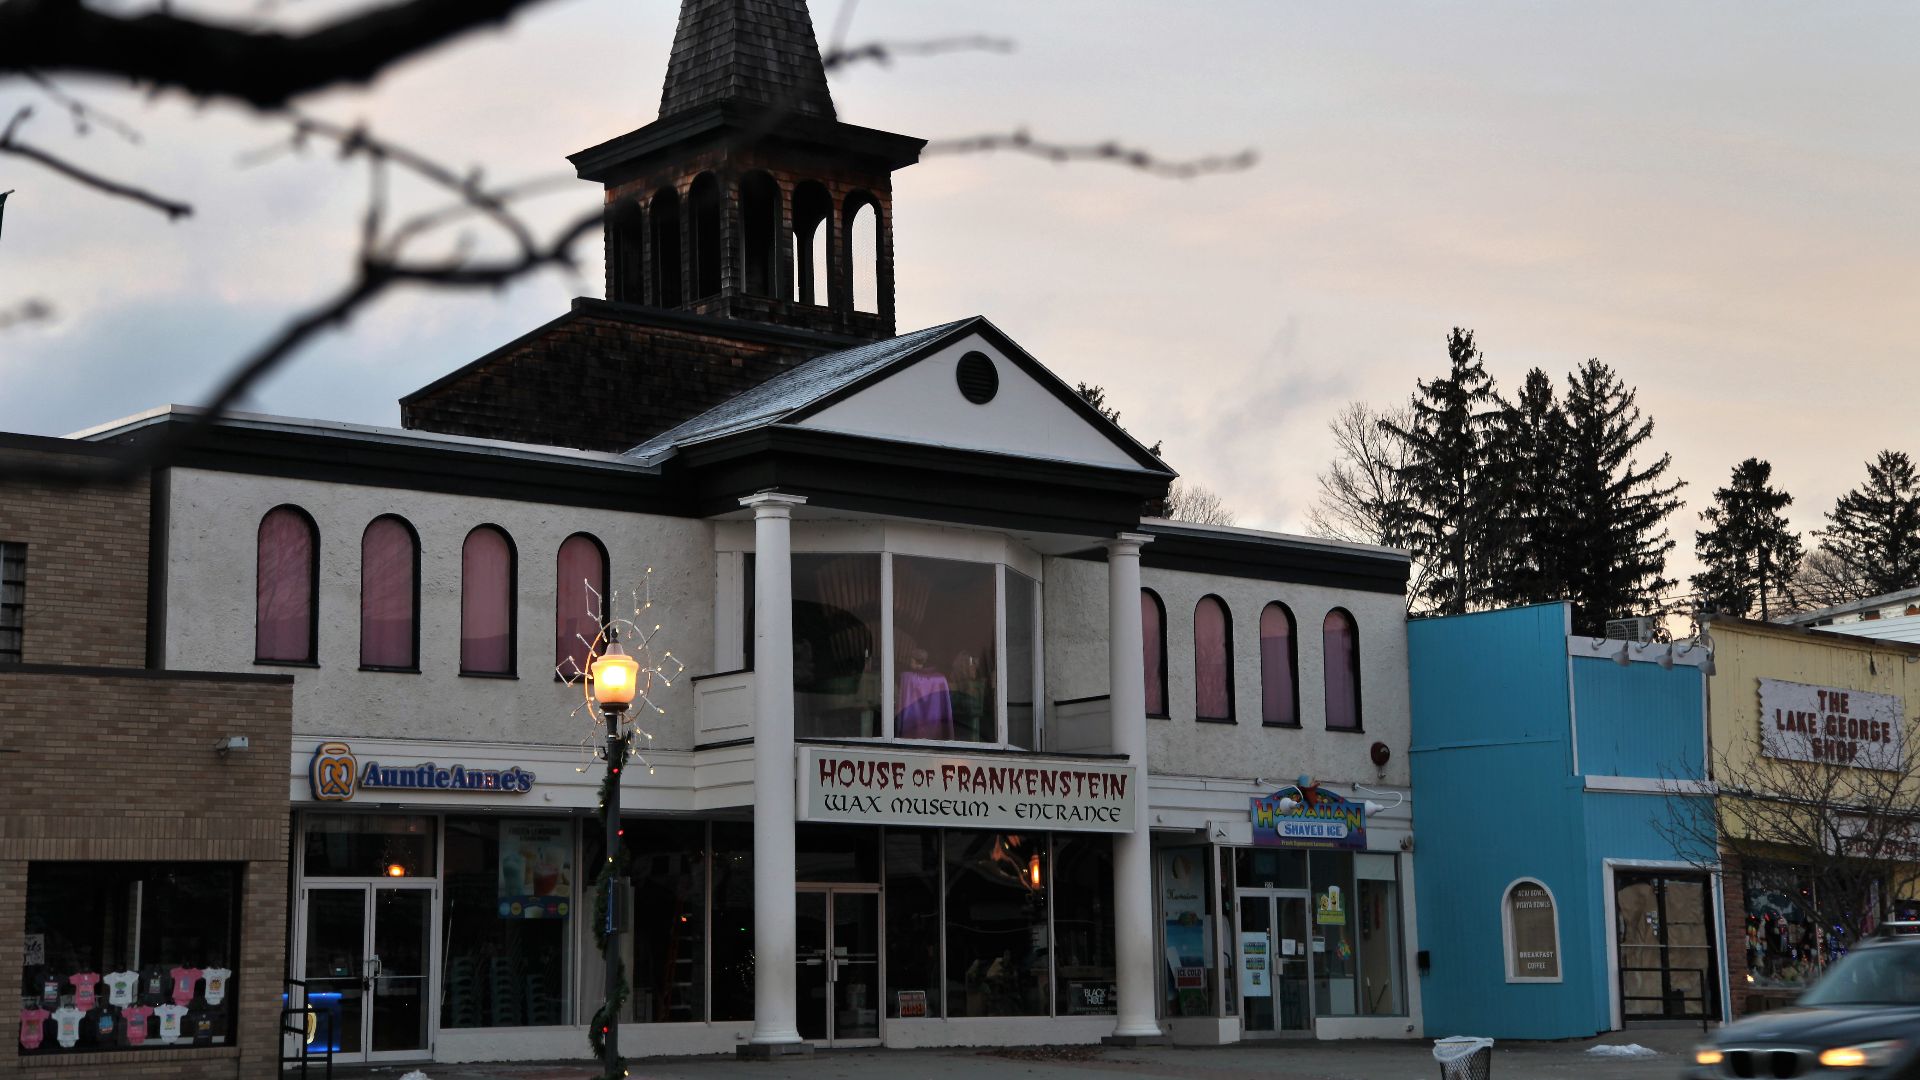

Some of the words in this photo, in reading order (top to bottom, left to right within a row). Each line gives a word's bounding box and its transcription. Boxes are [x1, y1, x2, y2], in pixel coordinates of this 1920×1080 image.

[1817, 690, 1850, 714] THE
[1776, 708, 1817, 735] LAKE
[1825, 714, 1891, 744] GEORGE
[1811, 737, 1858, 763] SHOP
[818, 758, 906, 790] HOUSE
[912, 768, 935, 788] OF
[940, 763, 1128, 801] FRANKENSTEIN
[823, 794, 883, 815] WAX
[891, 797, 990, 818] MUSEUM
[1015, 802, 1122, 823] ENTRANCE
[1284, 823, 1324, 836] SHAVED
[1326, 825, 1343, 837] ICE
[1519, 951, 1554, 959] BREAKFAST
[1177, 968, 1186, 976] ICE
[1187, 968, 1202, 977] COLD
